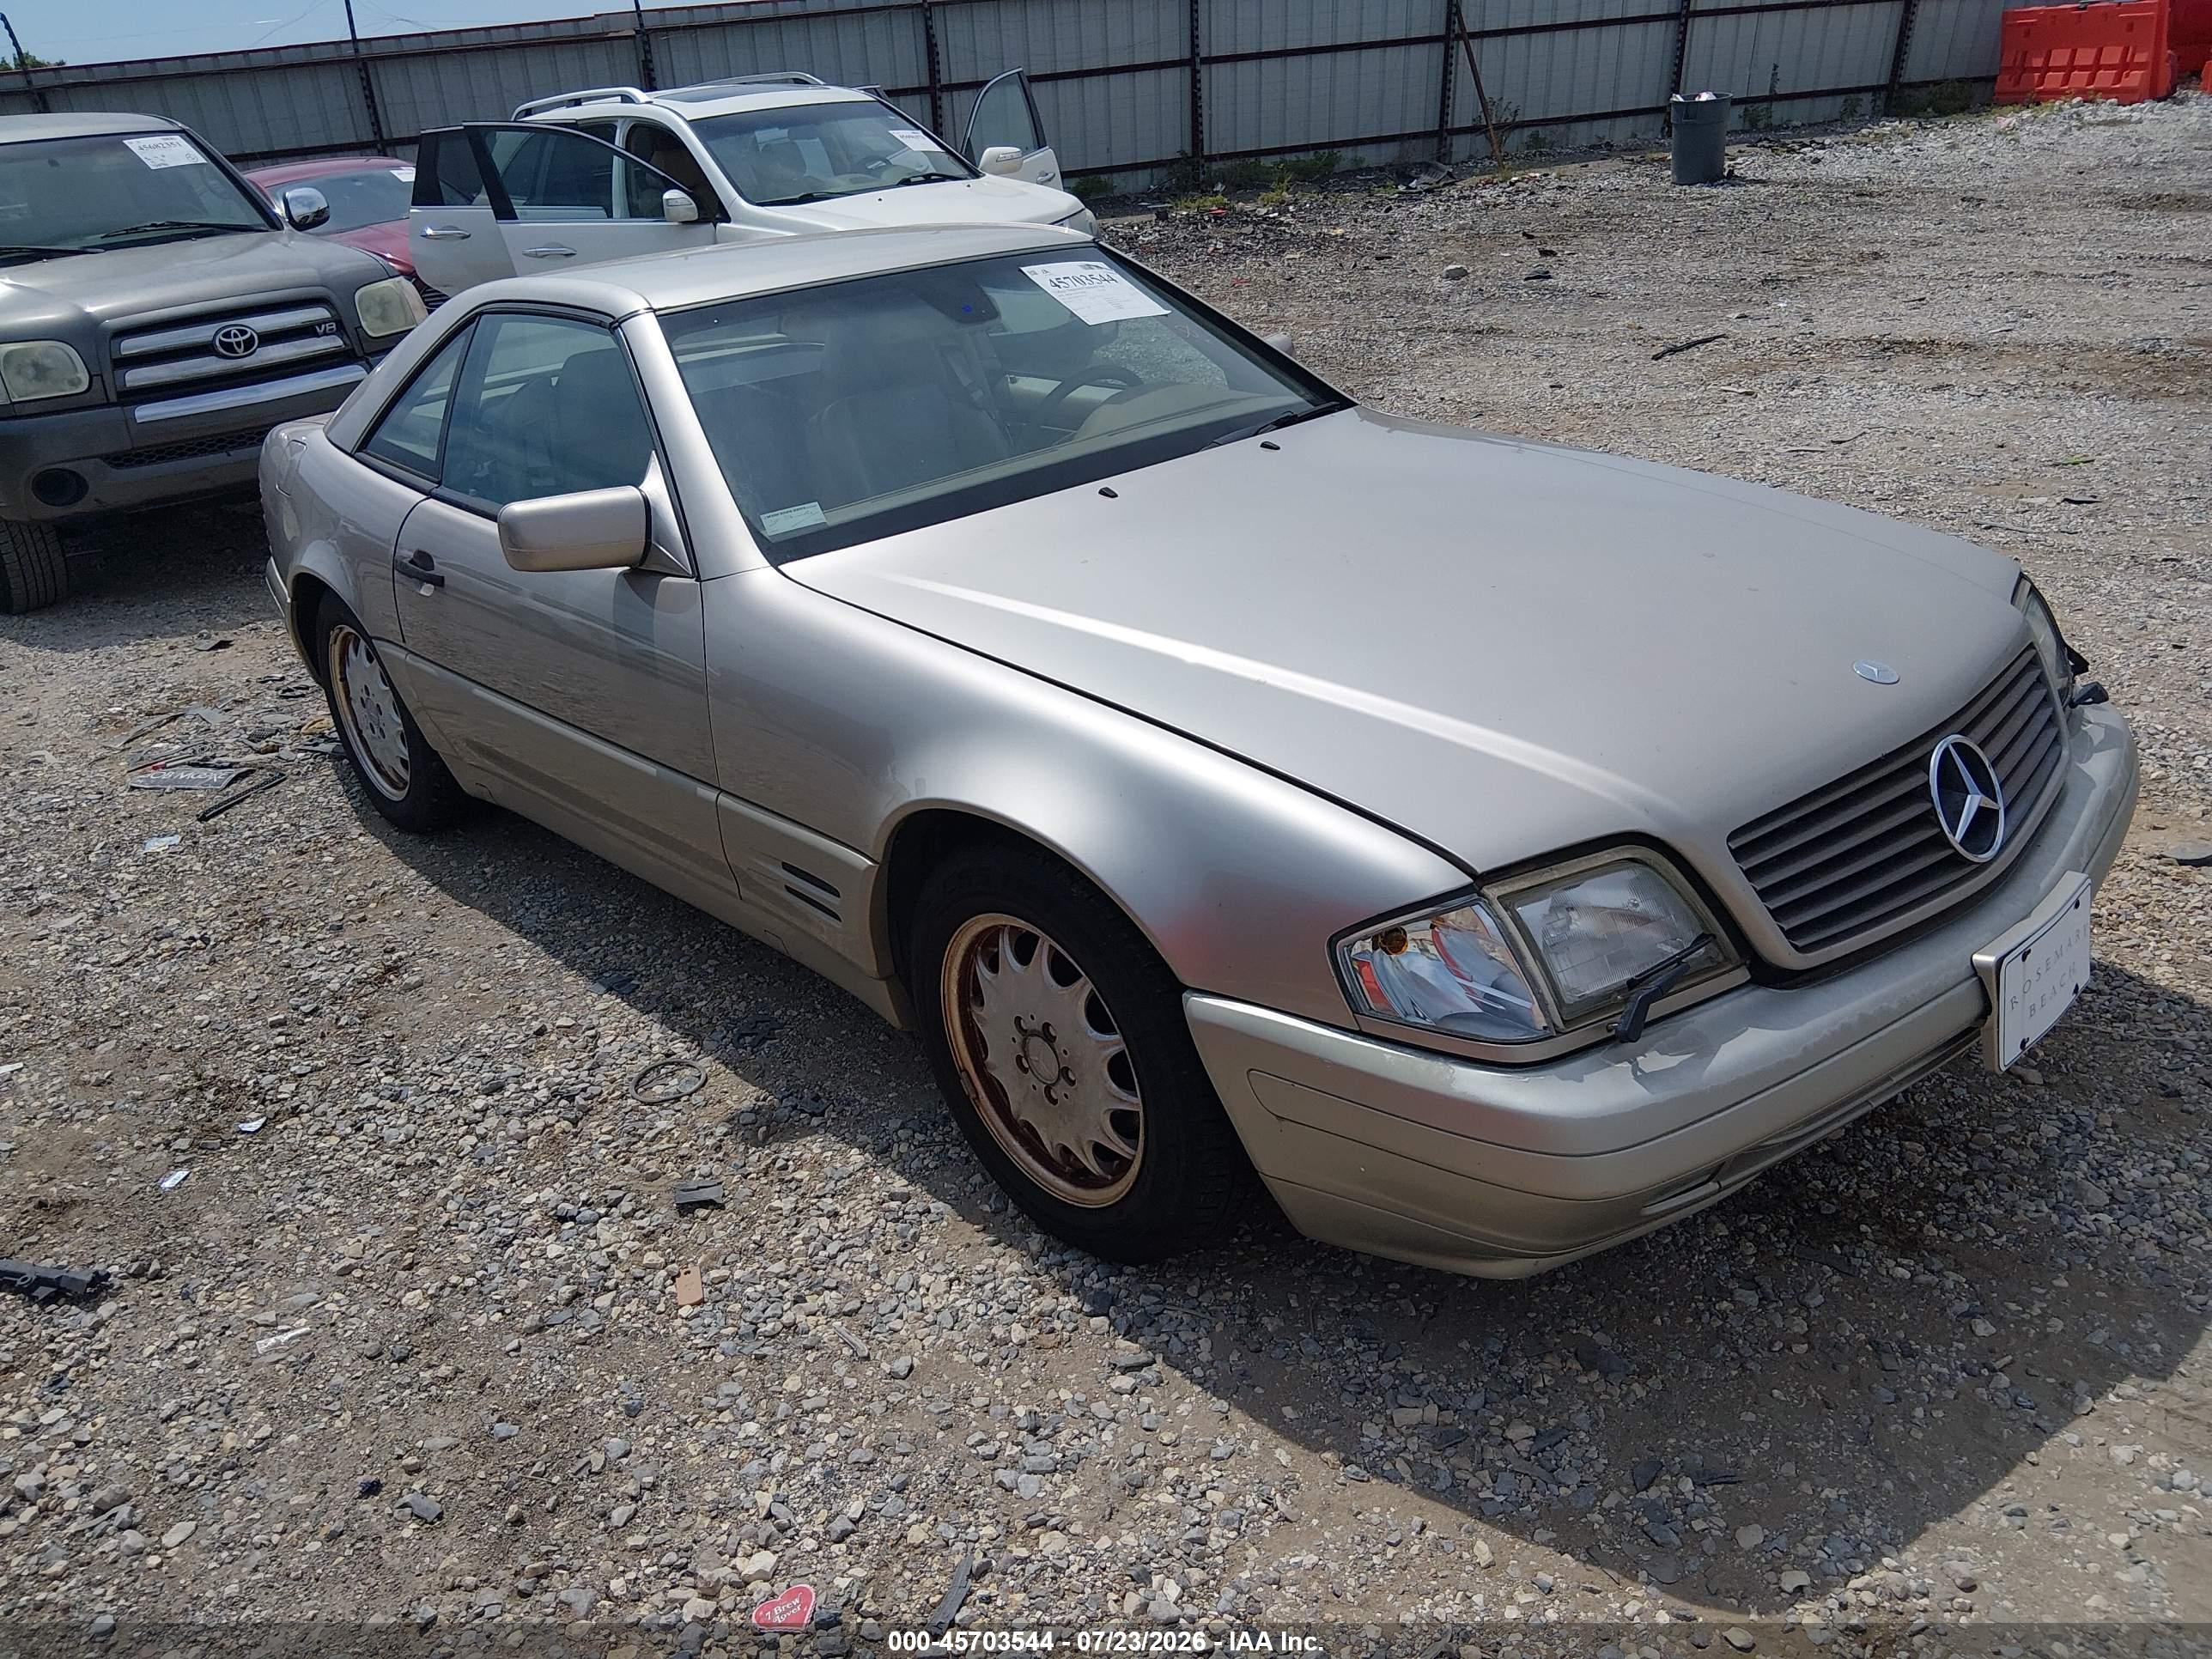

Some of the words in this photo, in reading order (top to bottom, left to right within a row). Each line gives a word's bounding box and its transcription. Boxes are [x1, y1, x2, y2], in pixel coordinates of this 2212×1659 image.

[1048, 273, 1119, 289] 45703544
[315, 322, 337, 336] V8
[2029, 961, 2077, 1018] BEACH
[765, 1611, 772, 1621] 7
[774, 1592, 803, 1615] Brew
